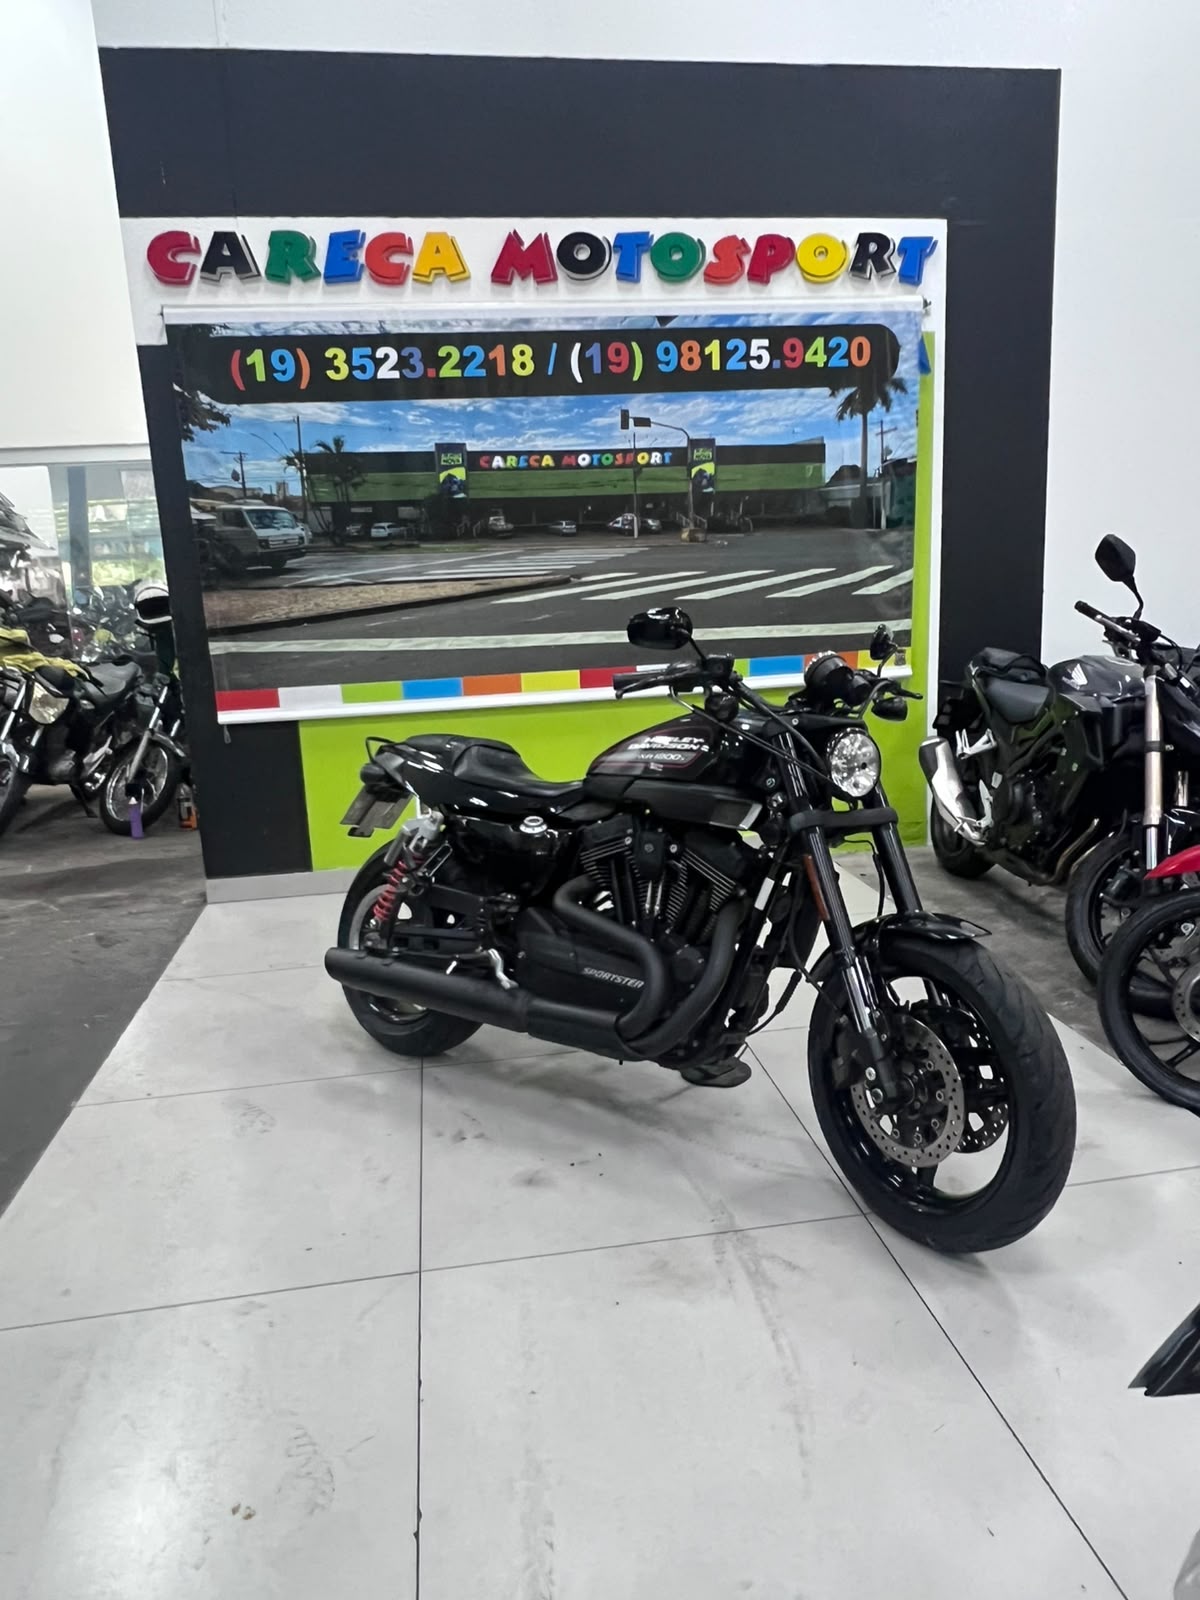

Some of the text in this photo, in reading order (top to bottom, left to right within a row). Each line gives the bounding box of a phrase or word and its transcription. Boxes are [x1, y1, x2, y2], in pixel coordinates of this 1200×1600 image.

[147, 229, 938, 285] CARECA MOTOSPORT
[231, 335, 871, 390] (19) 3523.2218 / (19) 98125.9420
[479, 454, 555, 469] CARECA
[561, 452, 673, 468] MOTOSPORT
[582, 967, 645, 988] SPORTSTER
